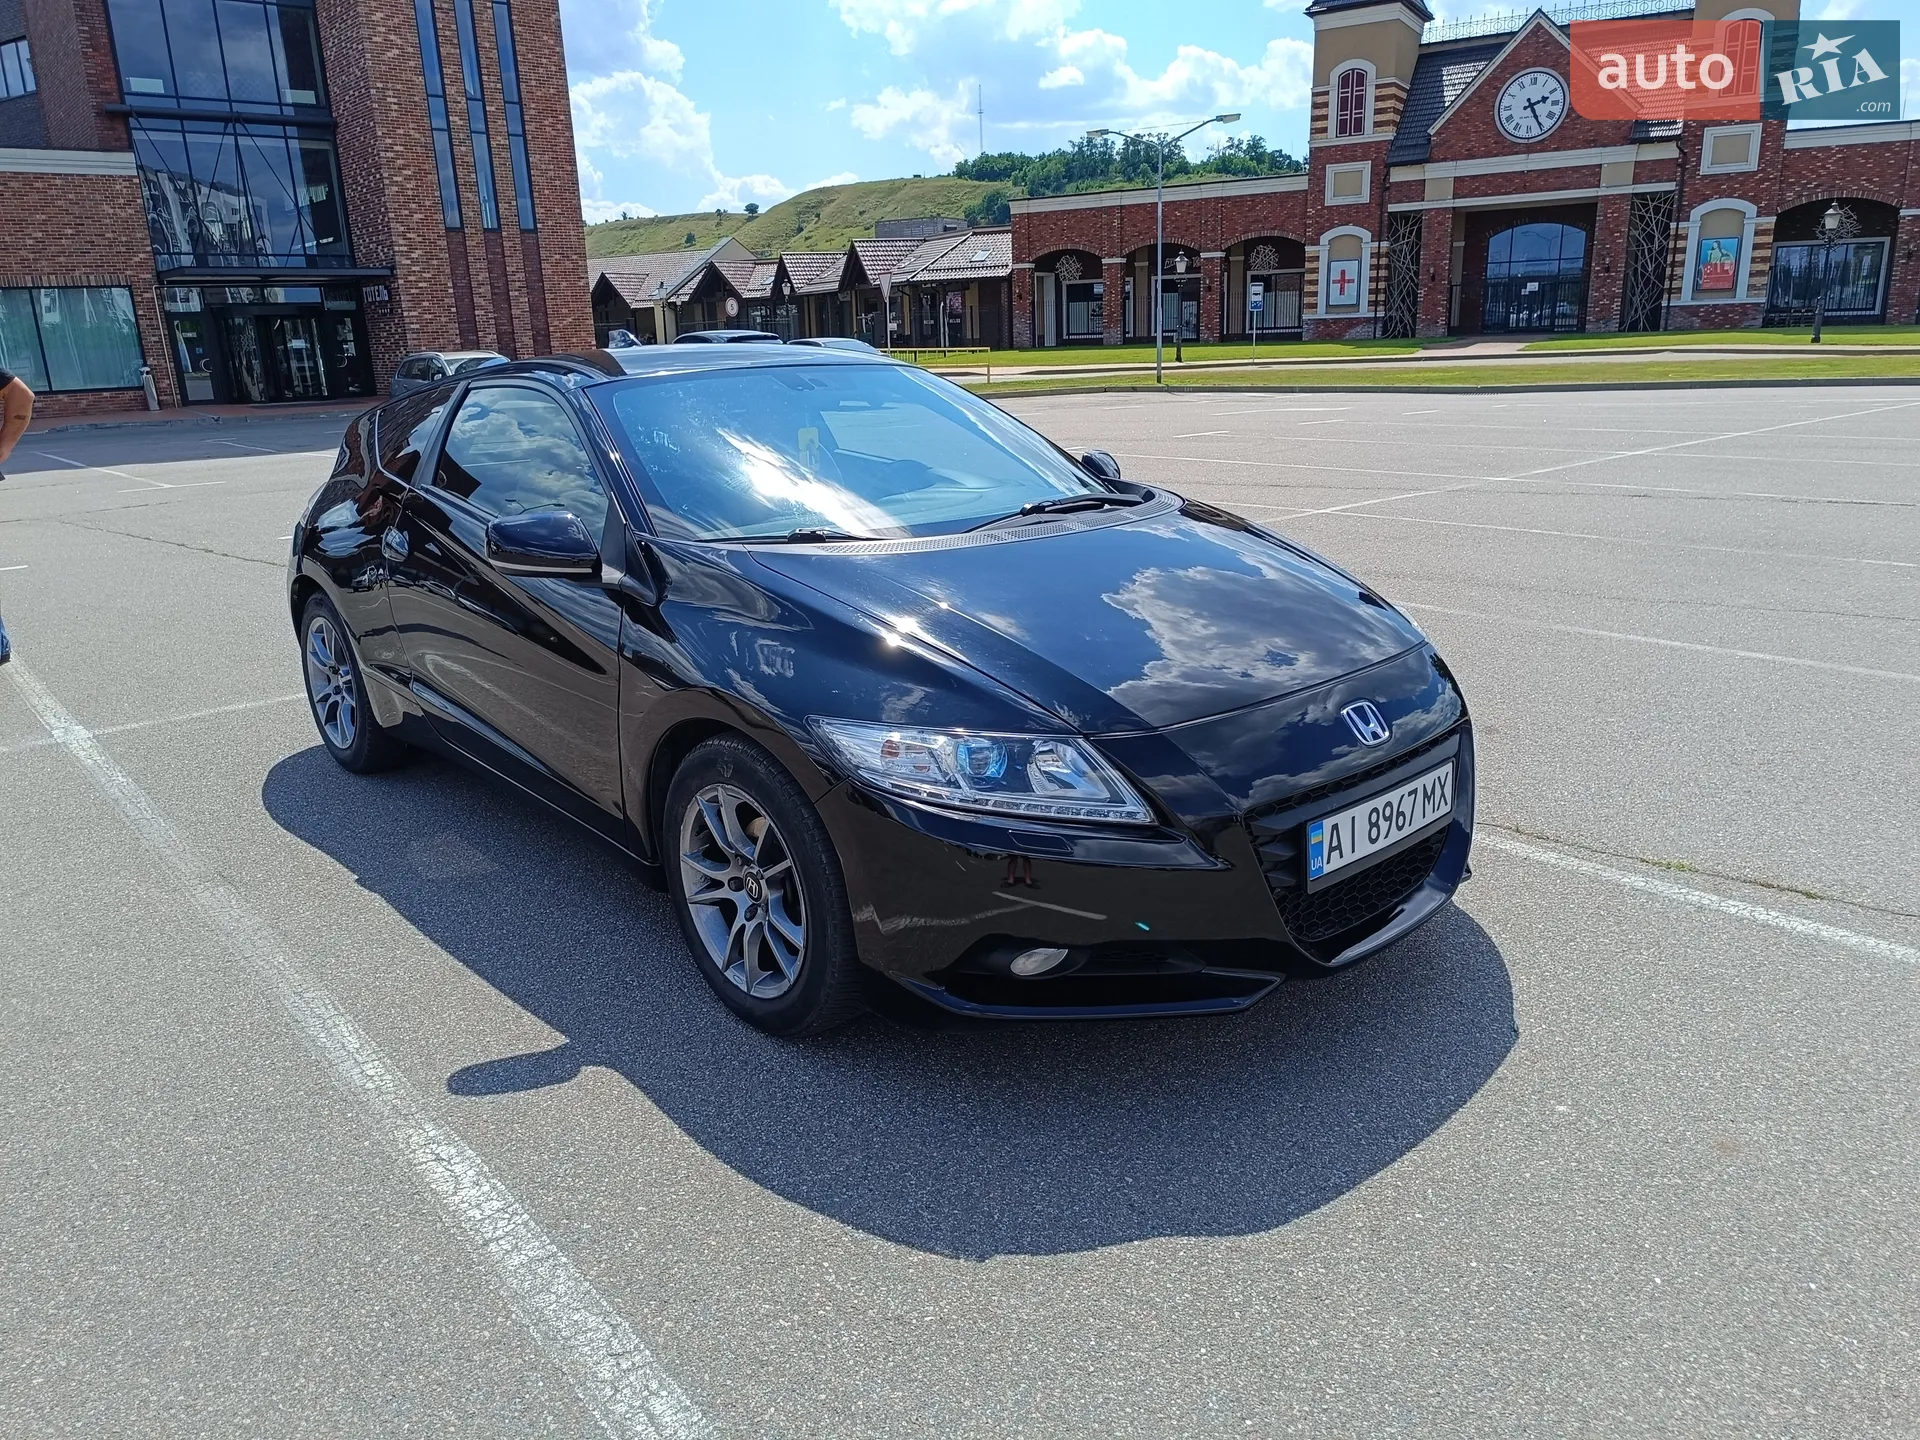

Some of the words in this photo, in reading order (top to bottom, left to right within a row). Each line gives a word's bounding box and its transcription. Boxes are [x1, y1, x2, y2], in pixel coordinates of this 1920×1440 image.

[362, 285, 389, 303] ГОТЕЛЬ
[1367, 786, 1419, 845] 8967
[1311, 856, 1323, 871] UA
